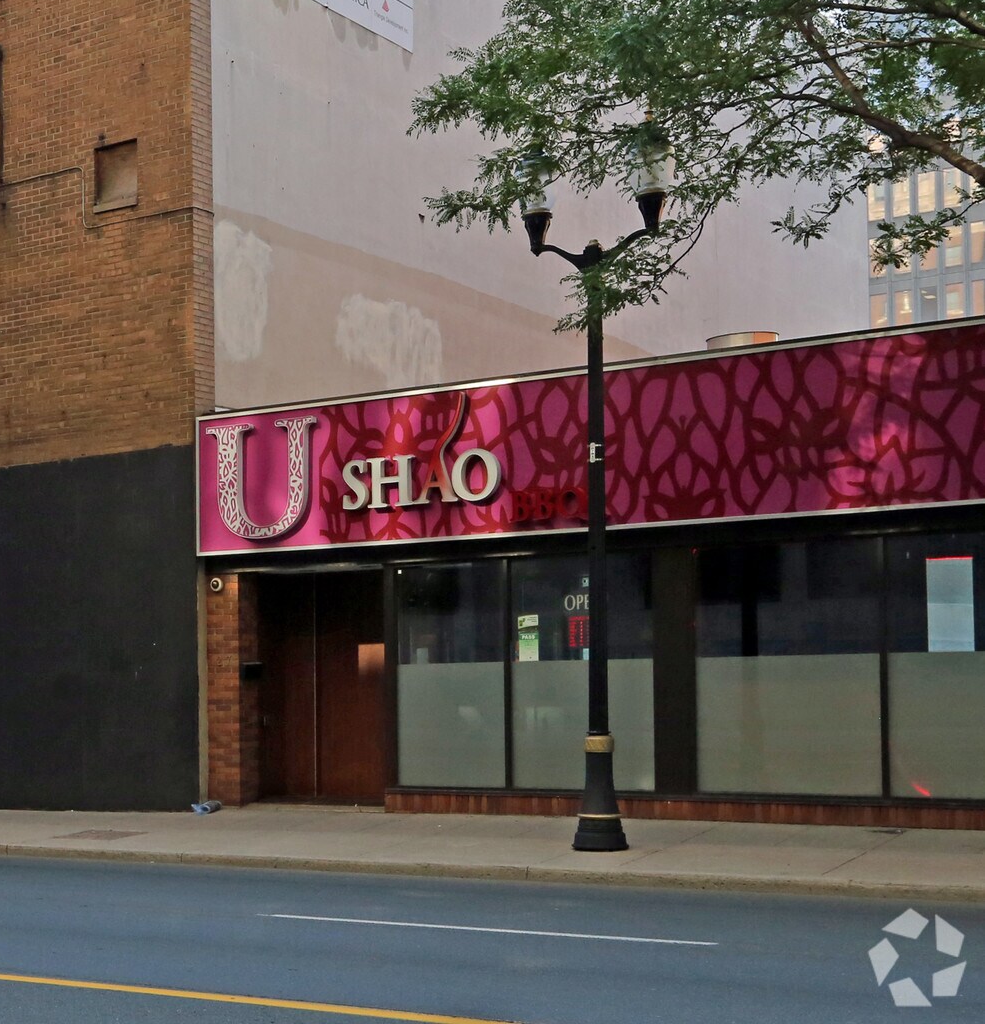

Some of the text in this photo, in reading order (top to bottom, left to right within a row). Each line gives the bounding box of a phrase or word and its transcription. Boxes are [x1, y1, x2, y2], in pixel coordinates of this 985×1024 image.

[205, 391, 502, 540] U SHAO
[564, 594, 590, 610] OPE
